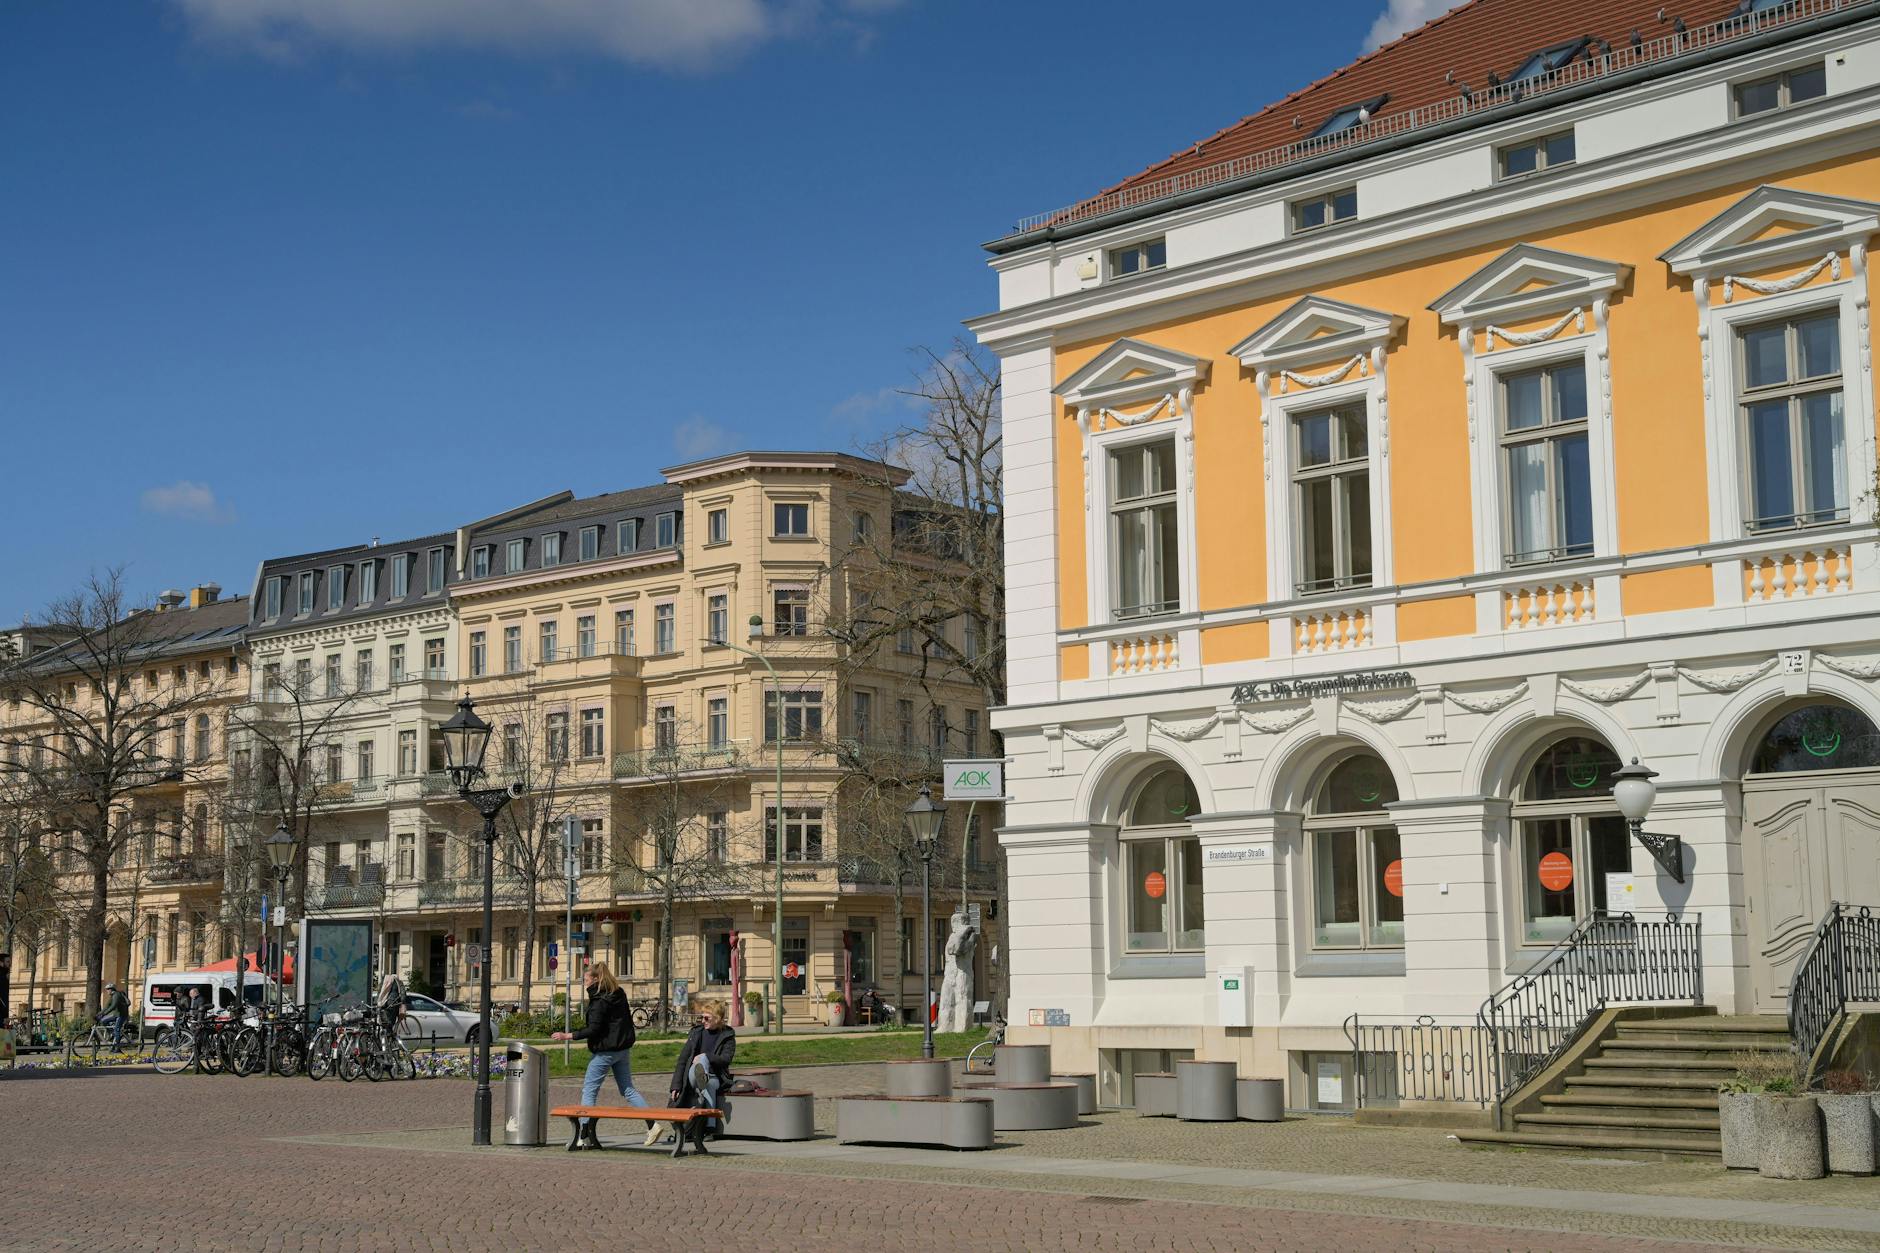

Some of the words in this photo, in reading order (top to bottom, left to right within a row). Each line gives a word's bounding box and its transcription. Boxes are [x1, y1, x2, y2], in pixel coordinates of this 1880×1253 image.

[1785, 654, 1803, 667] 72
[954, 770, 991, 786] AOK
[1209, 850, 1247, 860] Brandenburger
[1247, 848, 1265, 857] Straße
